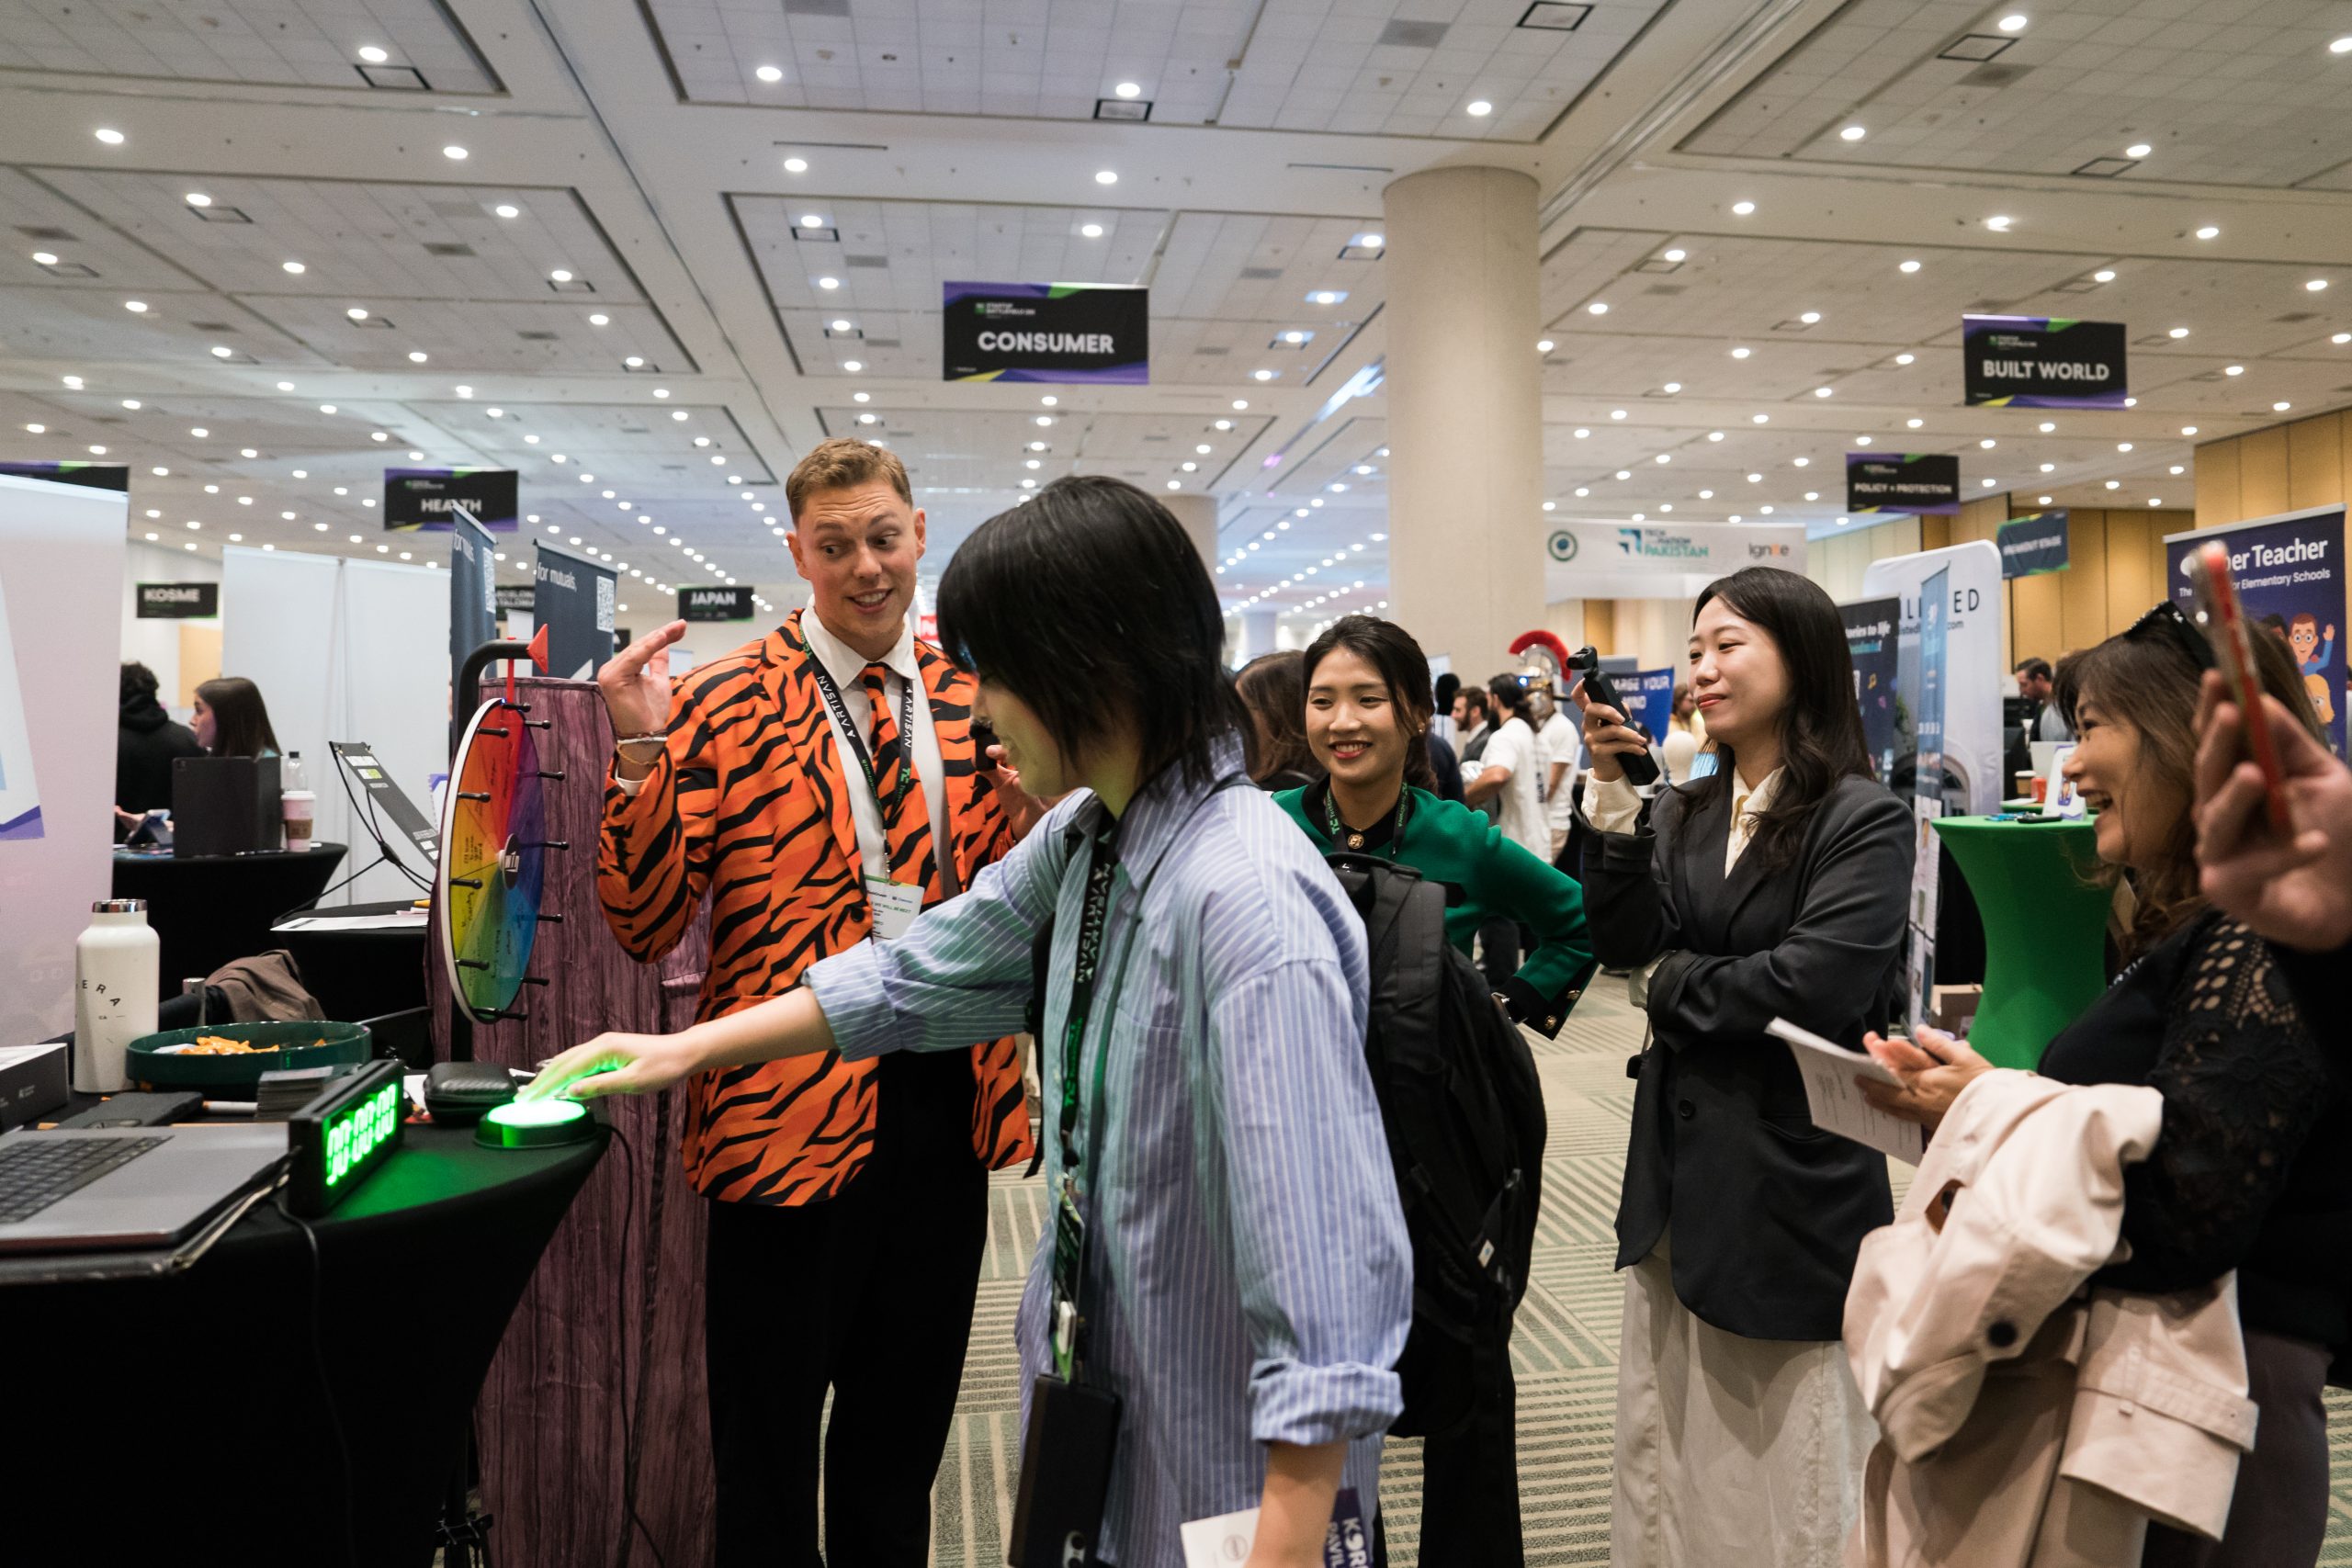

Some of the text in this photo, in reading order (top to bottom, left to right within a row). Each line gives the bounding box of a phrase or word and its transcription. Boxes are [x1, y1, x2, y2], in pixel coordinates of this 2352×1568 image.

[978, 332, 1114, 354] CONSUMER
[1983, 359, 2109, 380] BUILT WORLD
[1854, 482, 1887, 493] POLICY
[1896, 484, 1951, 494] PROTECTION
[421, 499, 481, 513] HEATH
[1645, 544, 1709, 558] PAKISTAN
[2251, 537, 2329, 569] Teacher
[537, 562, 548, 582] for
[2178, 587, 2192, 597] The
[2241, 573, 2292, 591] Elementary
[2293, 568, 2331, 583] Schools
[144, 588, 199, 602] KOSME
[691, 592, 736, 604] JAPAN
[1845, 625, 1867, 638] tories
[817, 675, 852, 728] ARTISAN
[903, 695, 914, 748] ARTISAN
[81, 979, 121, 1007] ERA
[1327, 1521, 1344, 1568] PAVIL
[1342, 1517, 1368, 1568] KOR
